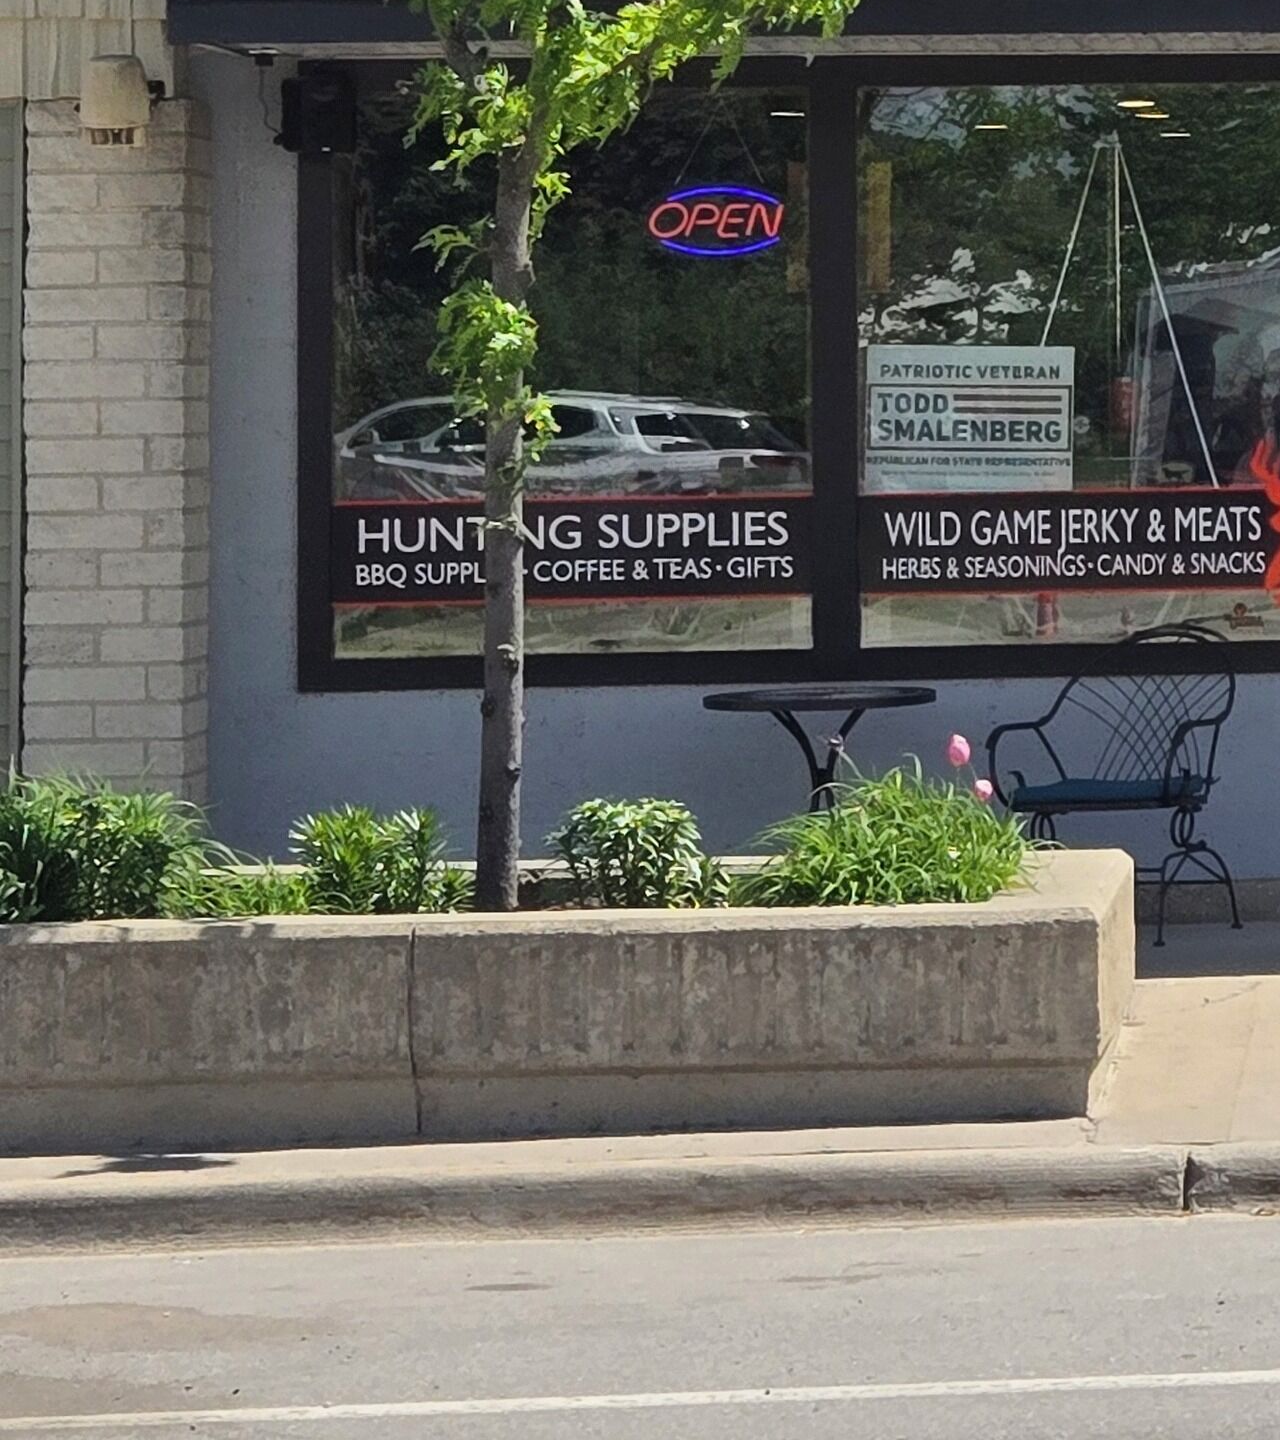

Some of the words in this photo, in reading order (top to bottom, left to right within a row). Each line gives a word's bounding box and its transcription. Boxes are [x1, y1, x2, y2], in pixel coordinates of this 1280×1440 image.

[648, 202, 784, 238] OPEN
[880, 364, 973, 379] PATRIOTIC
[977, 365, 1060, 379] VETERAN
[877, 393, 949, 413] TODD
[877, 419, 1062, 442] SMALENBERG
[358, 515, 582, 553] HUNTNG
[598, 511, 789, 548] SUPPLIES
[884, 511, 961, 546] WILD
[970, 510, 1051, 546] GAME
[1057, 508, 1139, 555] JERKY
[1147, 509, 1166, 542] &
[1175, 506, 1261, 542] MEATS
[355, 563, 407, 588] BBQ
[414, 562, 487, 584] SUPPL
[533, 560, 625, 582] COFFEE
[632, 558, 649, 580] &
[653, 557, 712, 579] TEAS
[726, 556, 793, 578] GIFTS
[882, 557, 941, 580] HERBS
[947, 557, 960, 579] &
[965, 554, 1086, 578] SEASONINGS
[1097, 553, 1167, 576] CANDY
[1172, 553, 1185, 575] &
[1190, 552, 1266, 574] SNACKS
